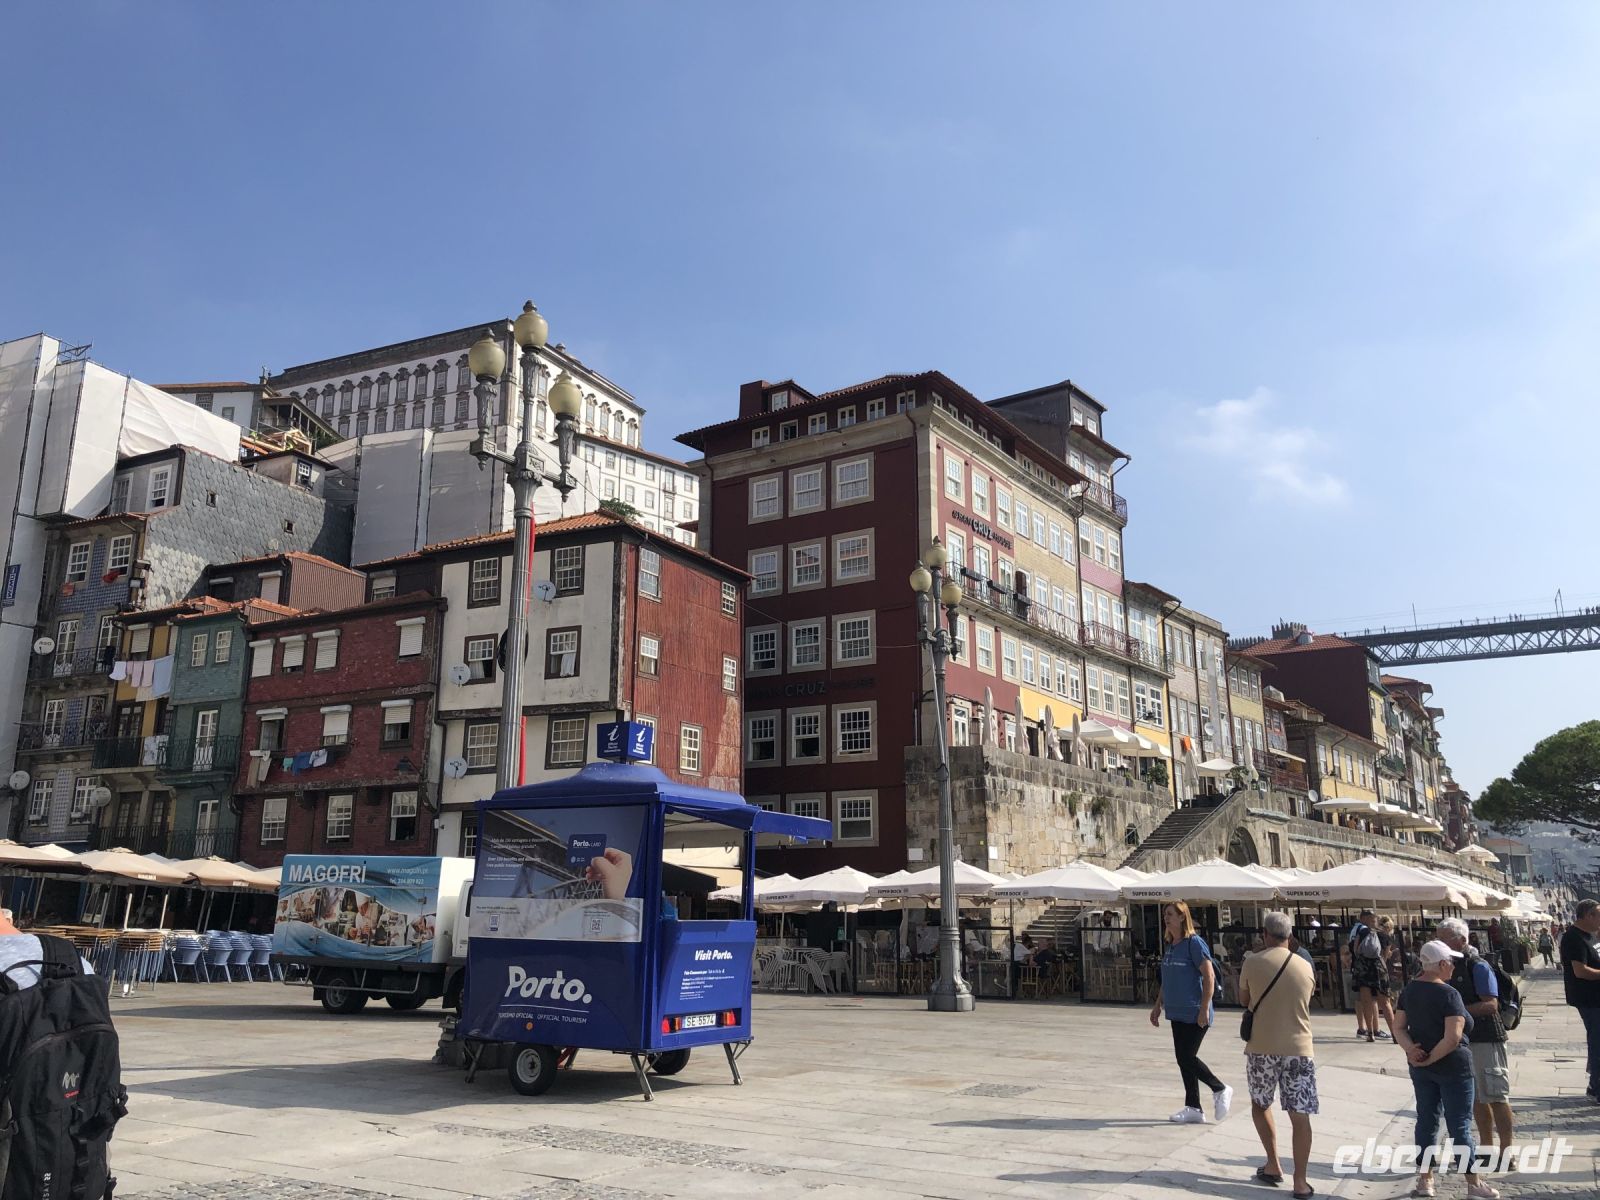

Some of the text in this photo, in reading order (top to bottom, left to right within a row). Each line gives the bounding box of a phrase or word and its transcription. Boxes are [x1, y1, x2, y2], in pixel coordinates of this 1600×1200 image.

[972, 519, 993, 541] CRUZ
[784, 681, 827, 697] CRUZ
[288, 864, 367, 883] MAGOFRI
[695, 949, 733, 961] Visit Porto.
[504, 965, 593, 1004] Porto.
[537, 1013, 560, 1022] OFFICIAL
[562, 1015, 588, 1024] TOURISM
[686, 1015, 714, 1027] SE 5574
